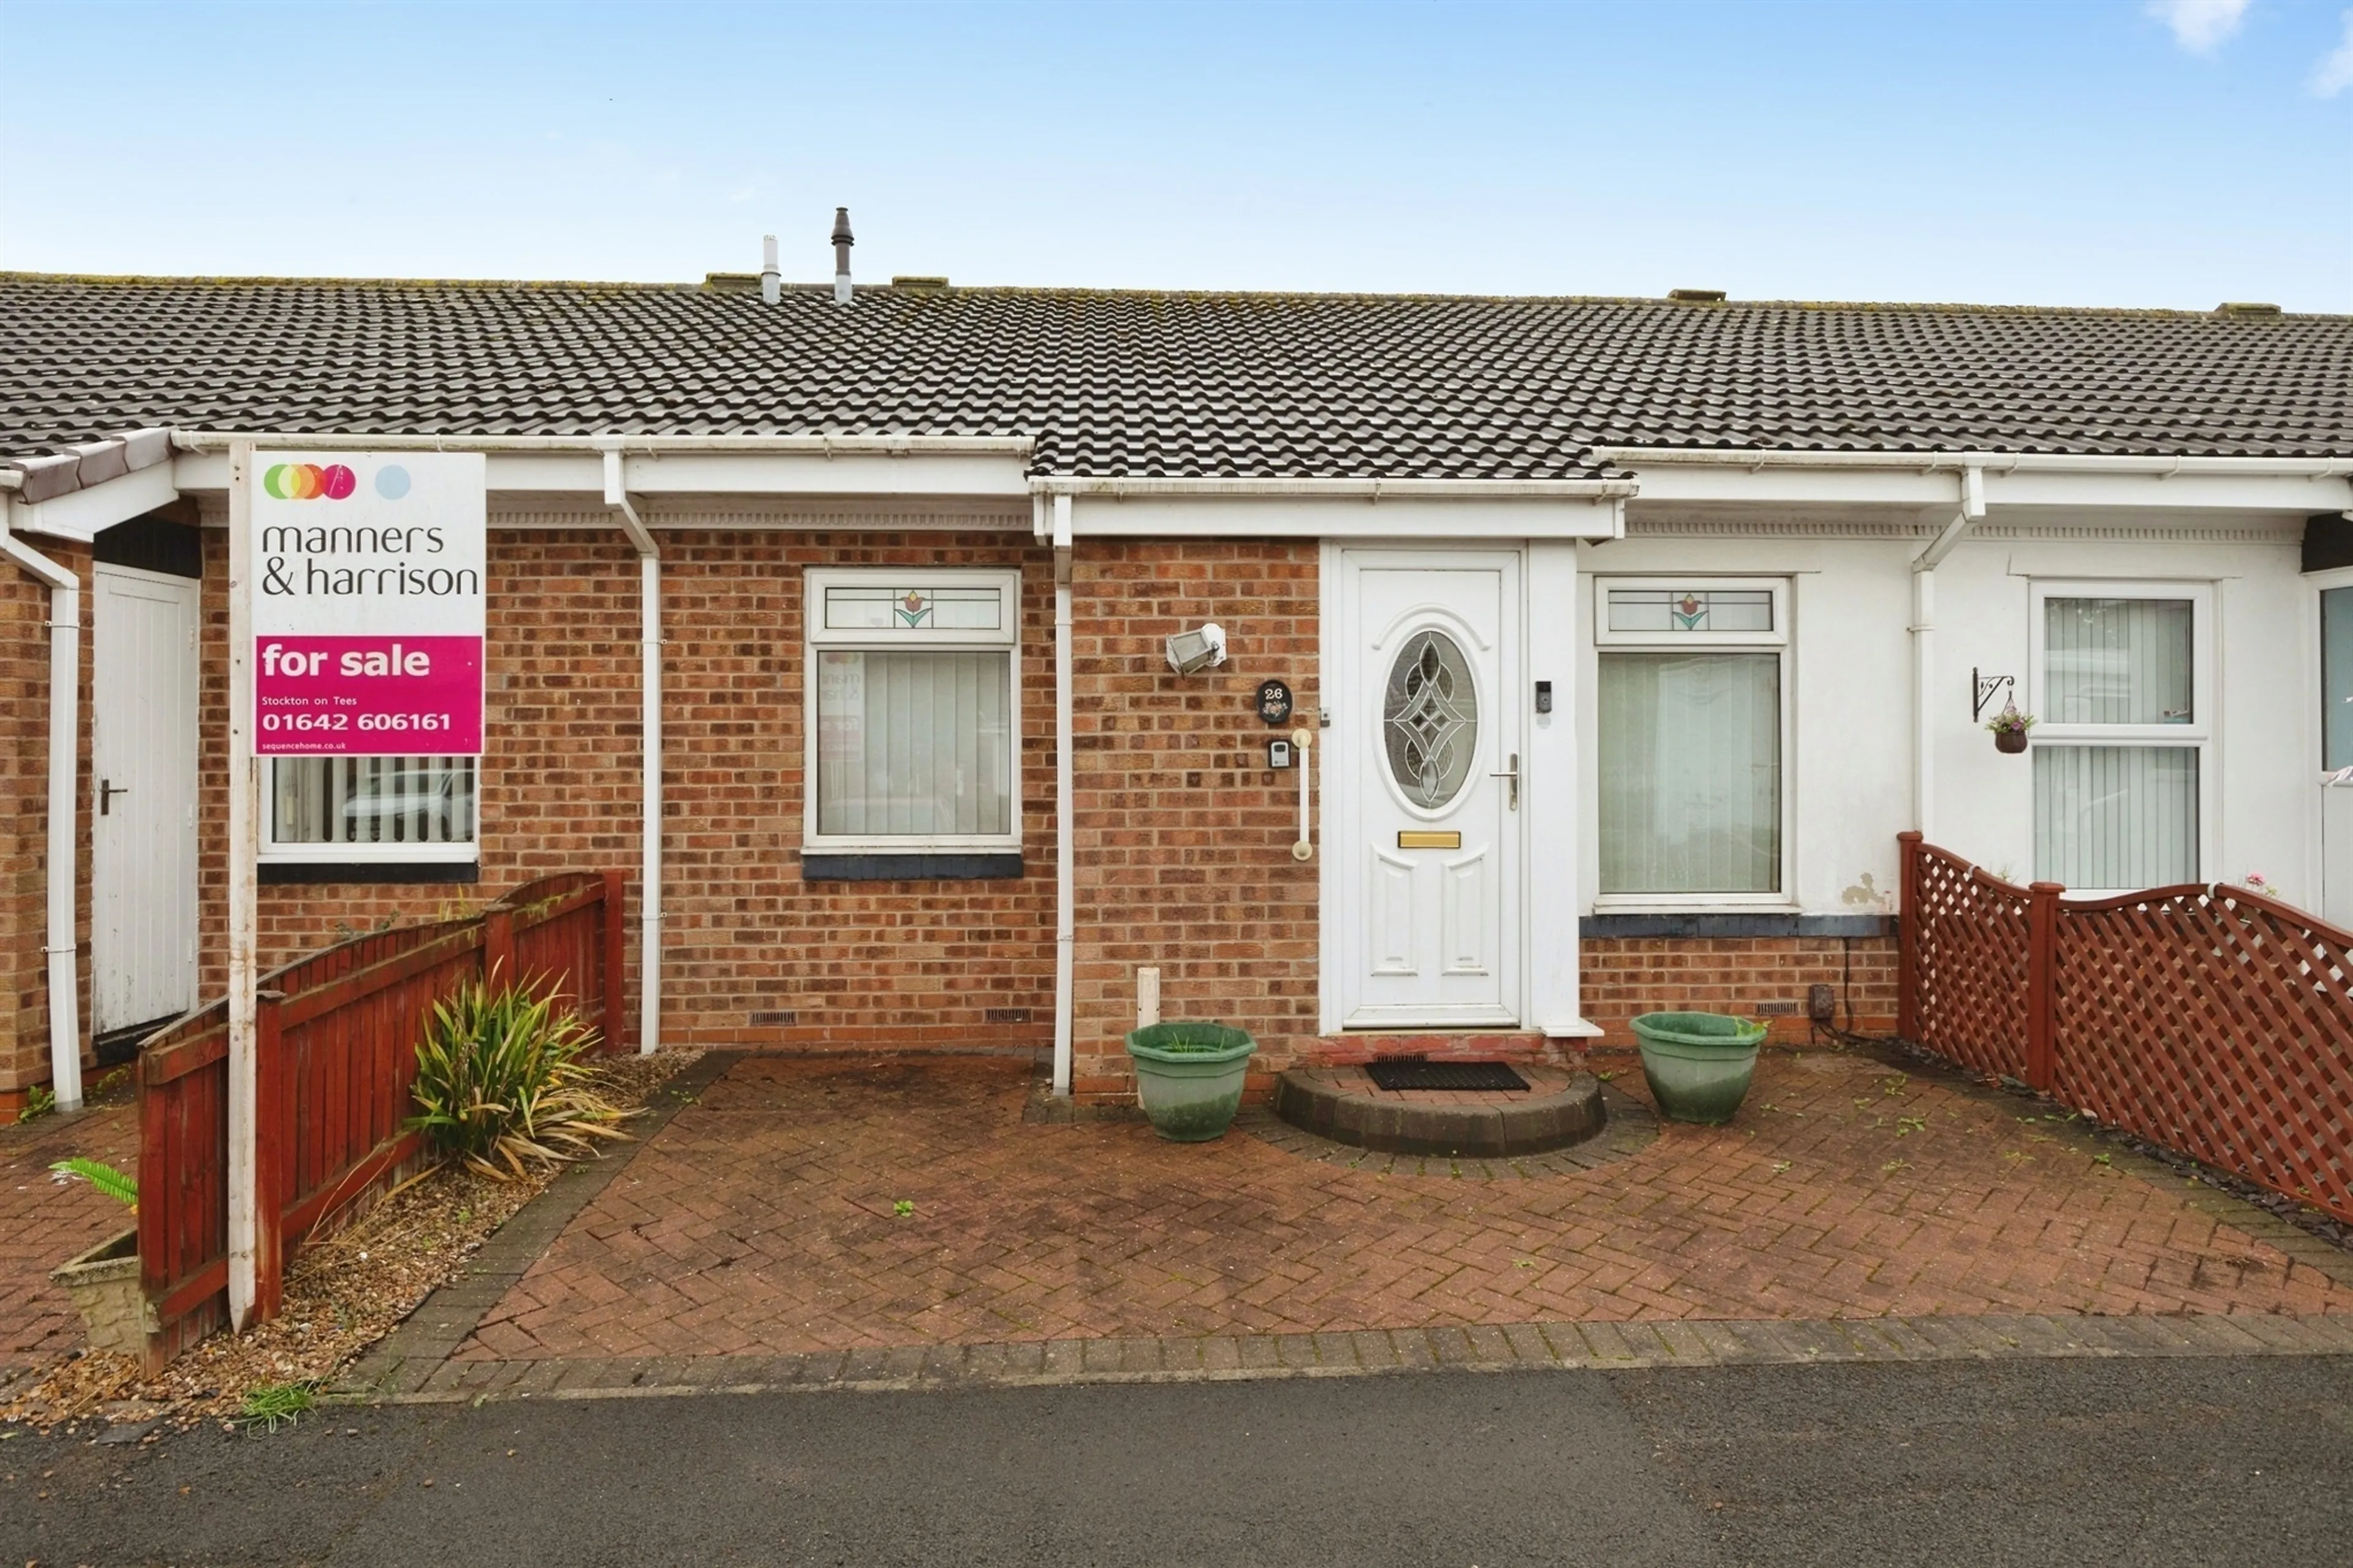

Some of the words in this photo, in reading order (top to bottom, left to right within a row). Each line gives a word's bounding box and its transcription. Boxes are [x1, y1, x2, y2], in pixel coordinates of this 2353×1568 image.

[262, 526, 444, 554] manners
[262, 556, 295, 596] &
[307, 558, 477, 596] harrison
[262, 643, 328, 676] for
[339, 643, 430, 676] sale
[262, 696, 309, 705] Stockton
[333, 696, 357, 705] Tees
[1264, 688, 1283, 700] 26
[262, 713, 349, 730] 01642
[357, 713, 450, 730] 606161
[262, 742, 346, 751] sequencehome.co.uk
